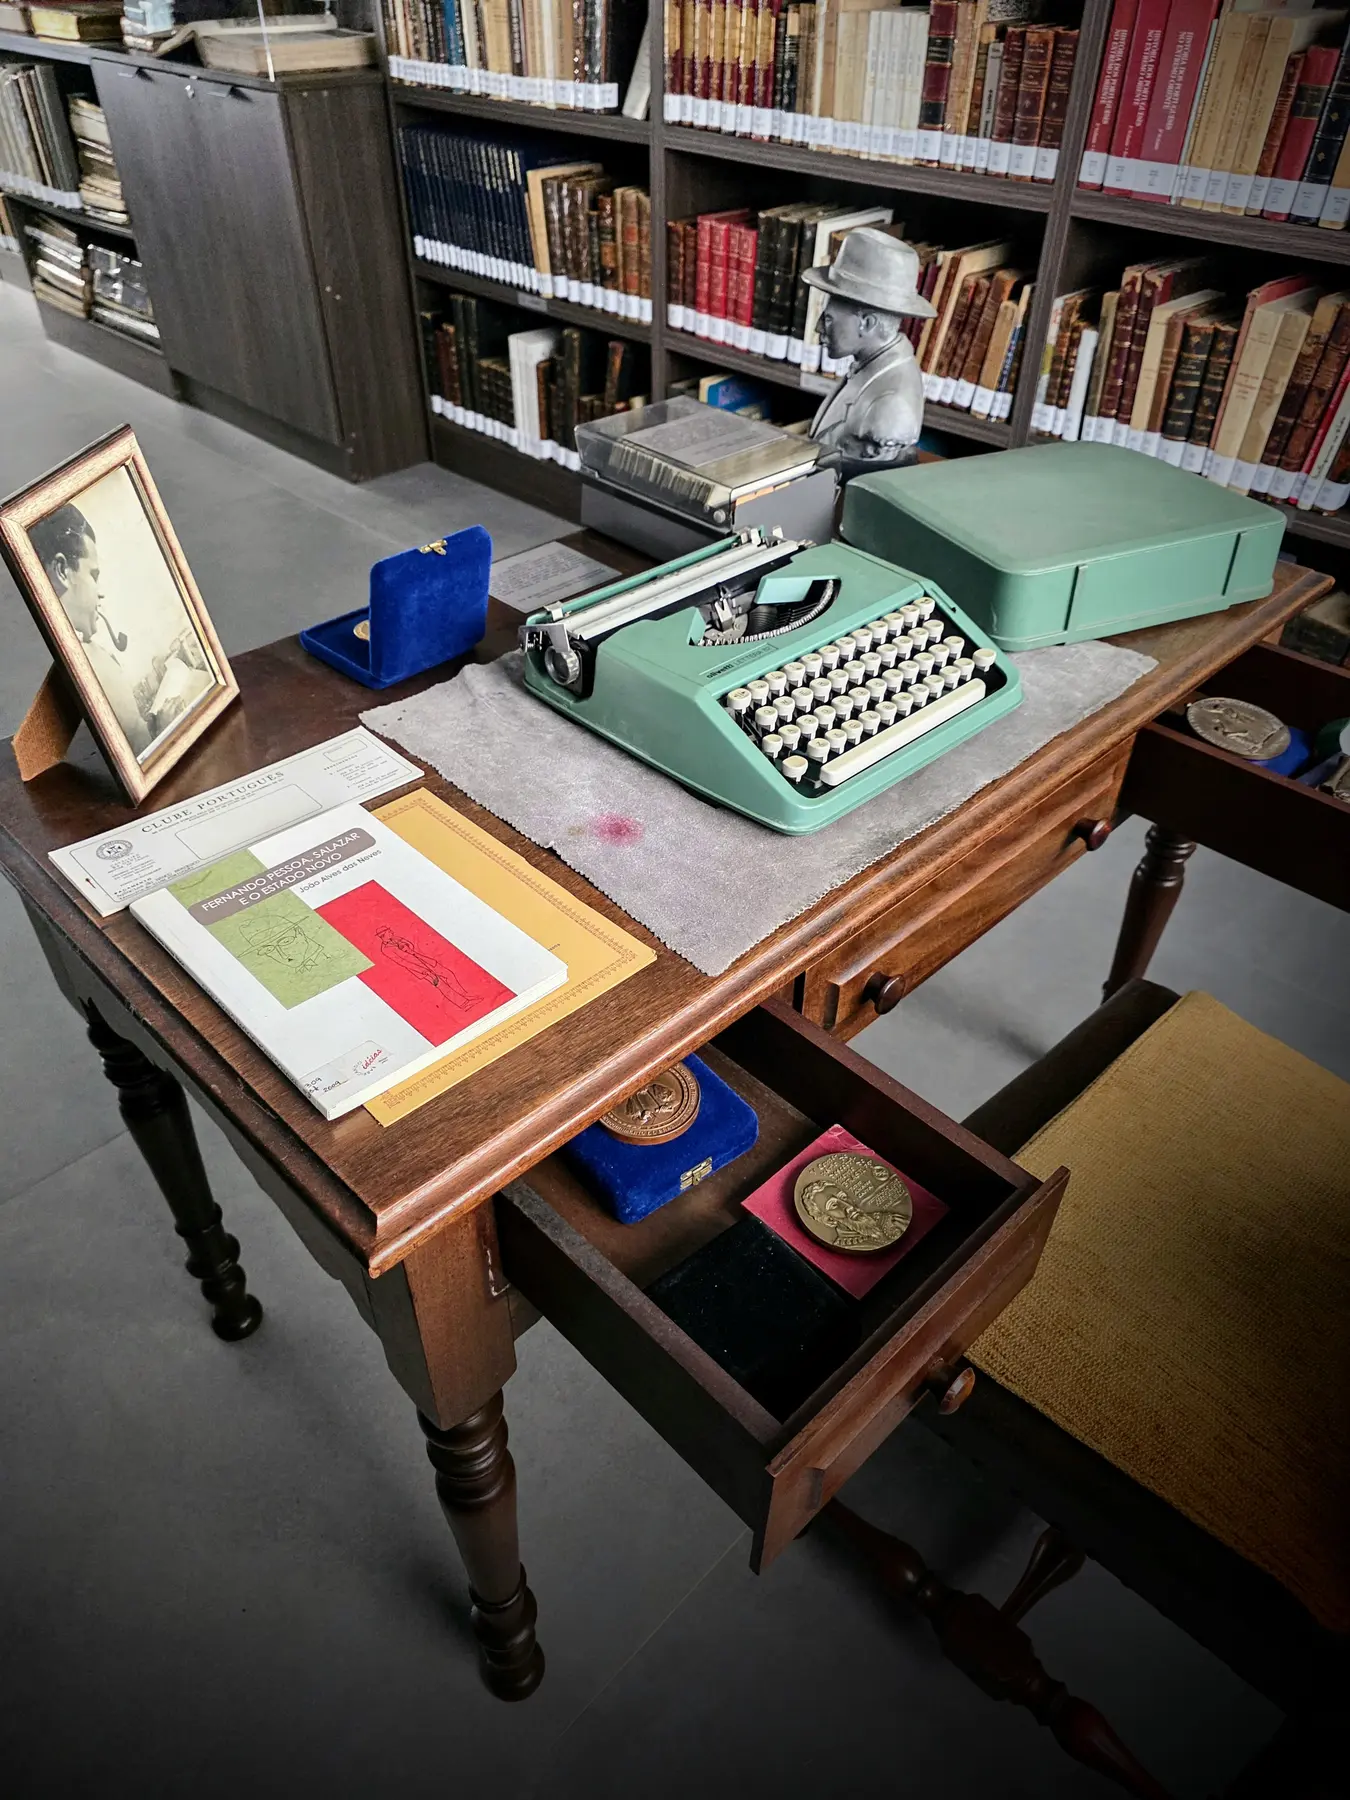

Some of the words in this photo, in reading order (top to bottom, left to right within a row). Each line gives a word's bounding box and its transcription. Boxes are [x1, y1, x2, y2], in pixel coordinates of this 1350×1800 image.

[707, 664, 734, 679] olivetti
[734, 651, 762, 666] LETTERA
[141, 809, 192, 833] CLUBE
[197, 771, 285, 810] PORTUGUÊS
[201, 878, 266, 911] FERNANDO
[268, 855, 314, 882] PESSOA,
[313, 832, 360, 859] SALAZAR
[239, 898, 250, 906] E
[250, 891, 261, 901] O
[263, 870, 305, 895] ESTADO
[307, 852, 342, 875] NOVO
[299, 880, 320, 893] João
[321, 868, 342, 883] Alves
[342, 861, 358, 873] das
[358, 849, 382, 864] Neves
